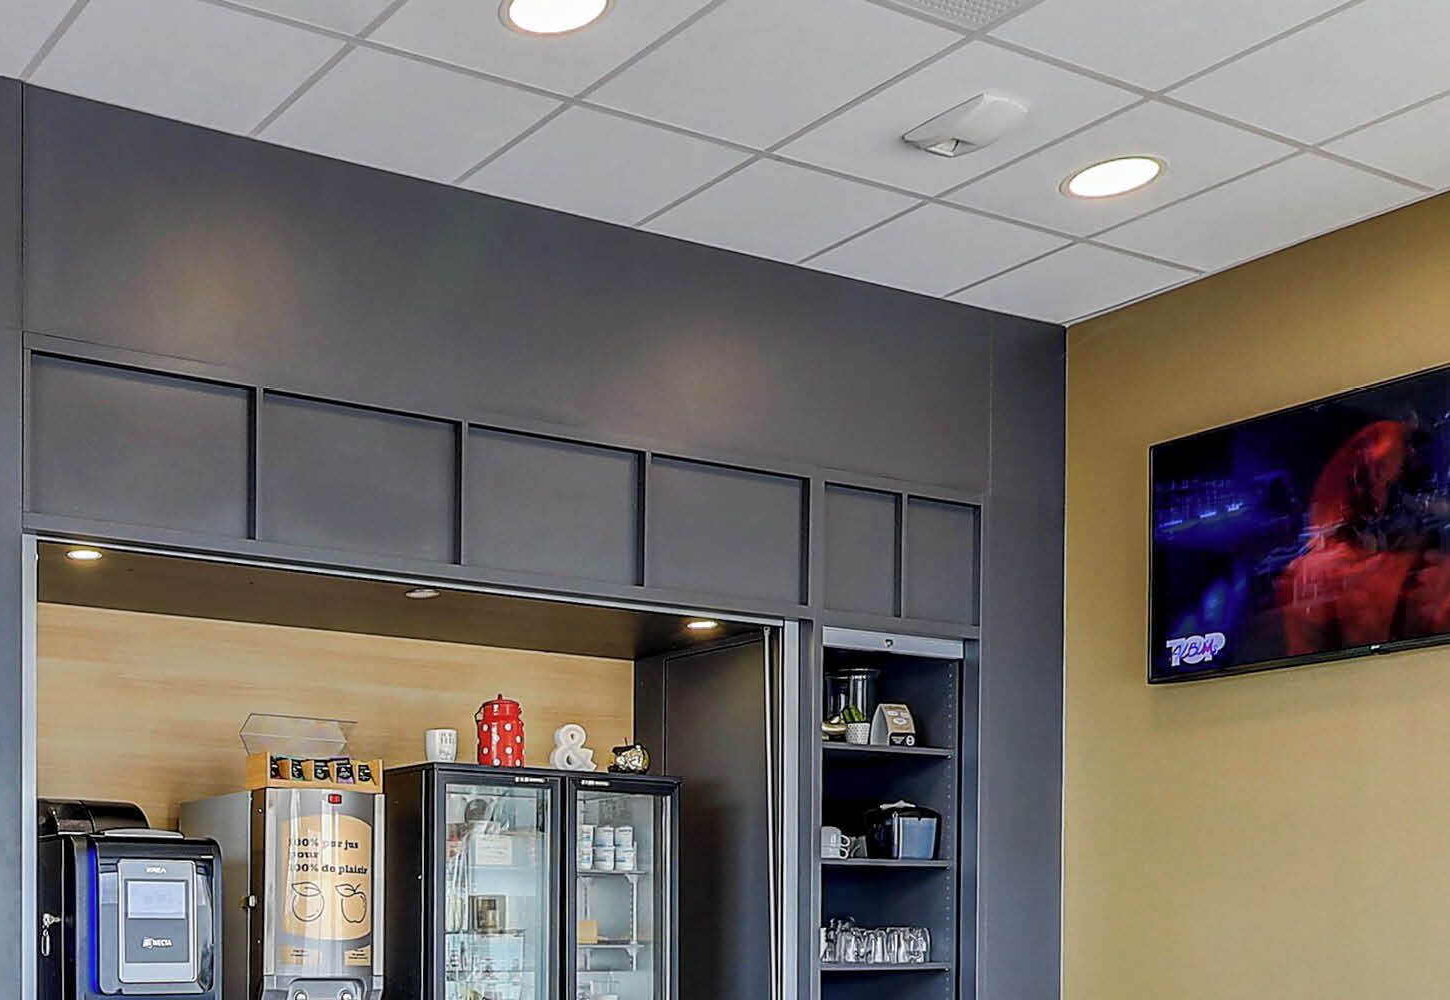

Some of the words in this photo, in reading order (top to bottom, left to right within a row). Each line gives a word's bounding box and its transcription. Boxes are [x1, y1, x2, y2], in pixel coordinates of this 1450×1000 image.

[1166, 632, 1226, 667] TOP
[344, 840, 359, 851] jus
[338, 865, 368, 876] plaisir
